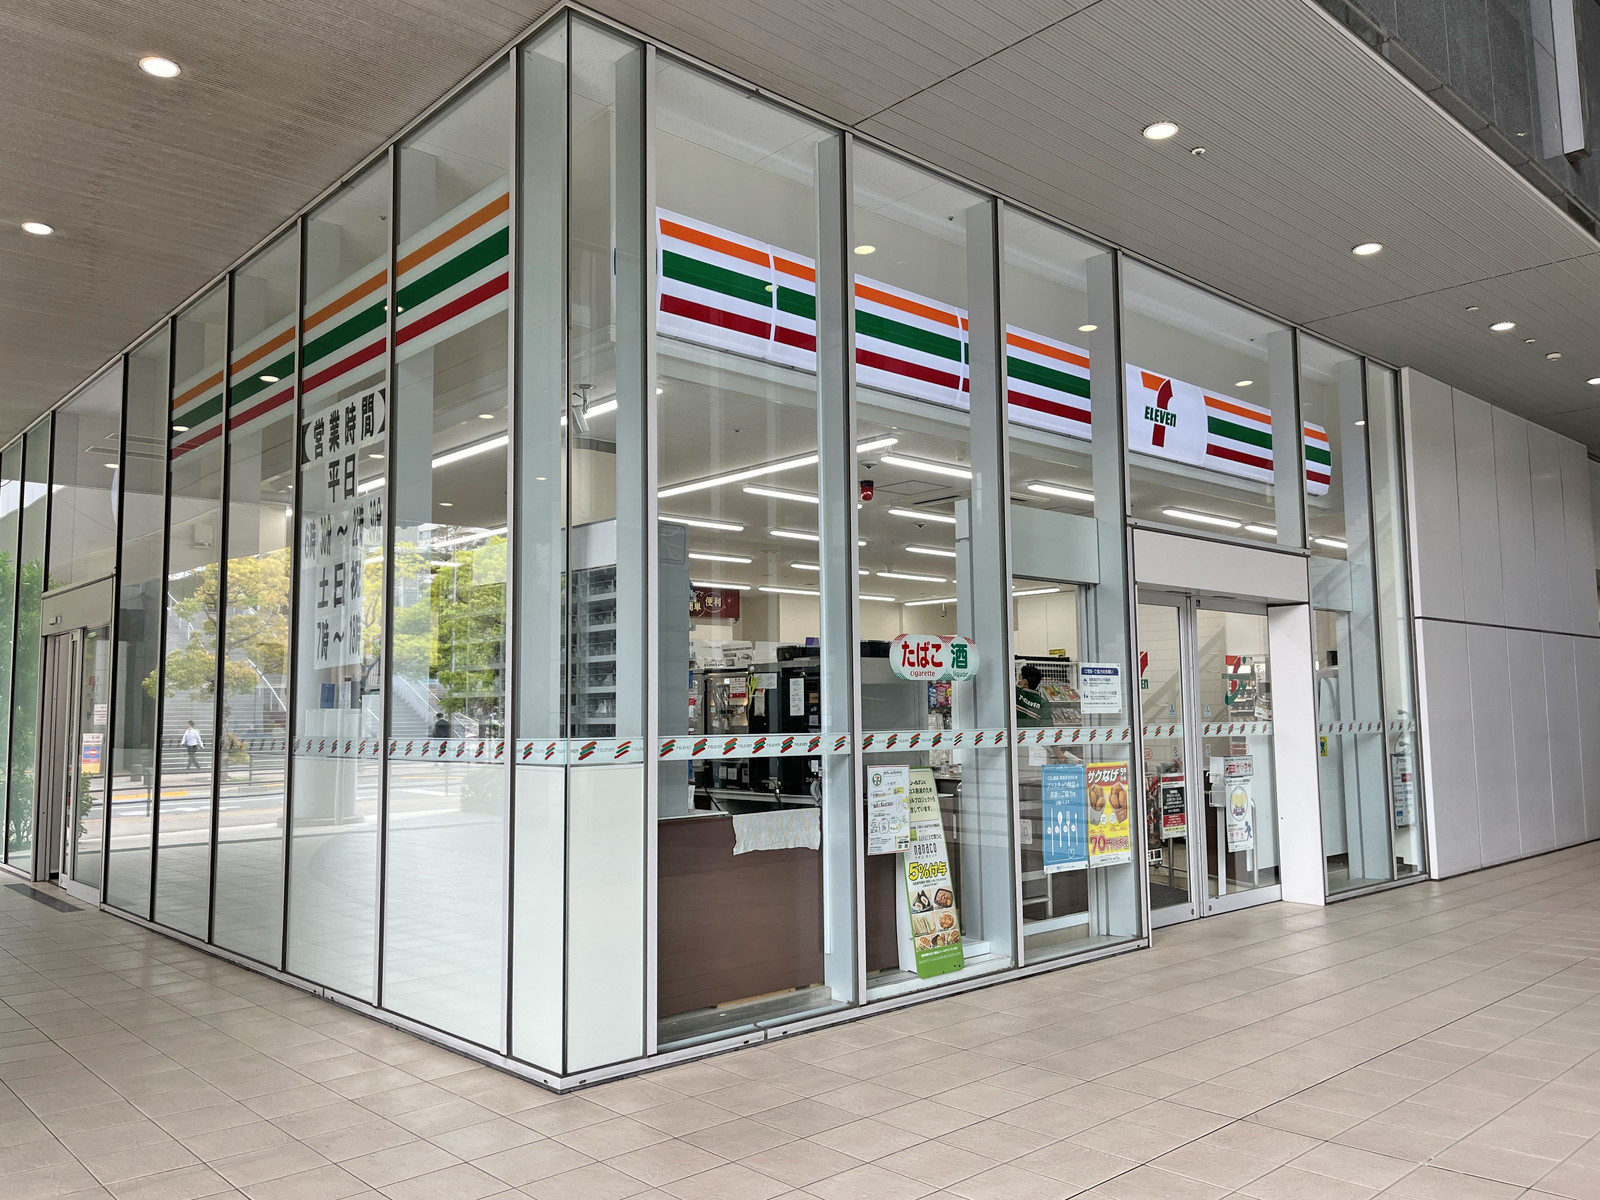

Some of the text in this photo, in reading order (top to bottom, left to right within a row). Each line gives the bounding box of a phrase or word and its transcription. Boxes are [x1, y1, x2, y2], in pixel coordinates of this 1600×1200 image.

[328, 453, 356, 503] 平日
[317, 559, 361, 609] 土日祝
[901, 640, 968, 669] たばこ 酒
[910, 669, 969, 678] cigarette liquor
[913, 842, 938, 856] nanaco
[908, 860, 948, 882] 5%付与
